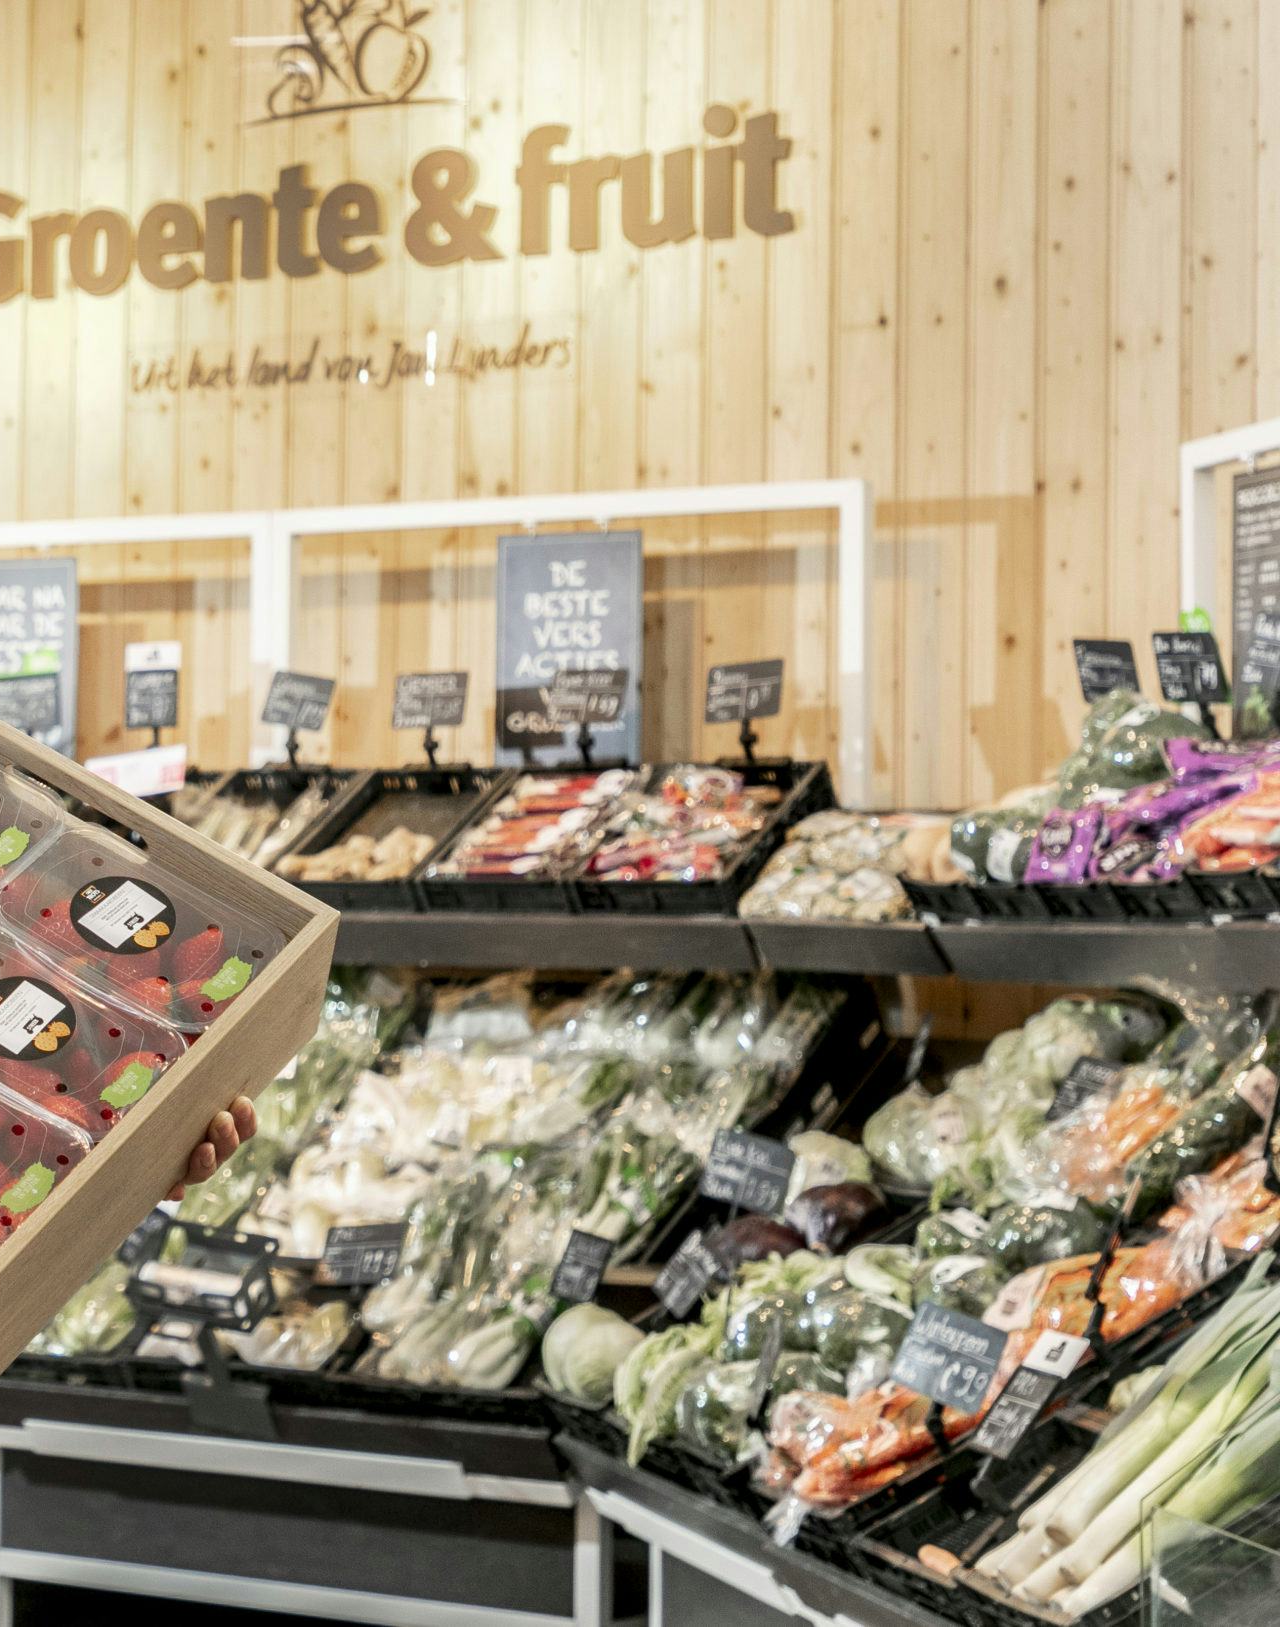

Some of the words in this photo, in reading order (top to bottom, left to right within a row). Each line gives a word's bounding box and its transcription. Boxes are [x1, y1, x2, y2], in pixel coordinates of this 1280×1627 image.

[404, 147, 502, 267] &
[516, 104, 797, 256] fruit
[187, 347, 238, 390] het
[247, 336, 321, 391] land
[323, 354, 377, 386] van
[548, 559, 587, 589] DE
[523, 589, 611, 620] BESTE
[532, 619, 603, 649] VERS
